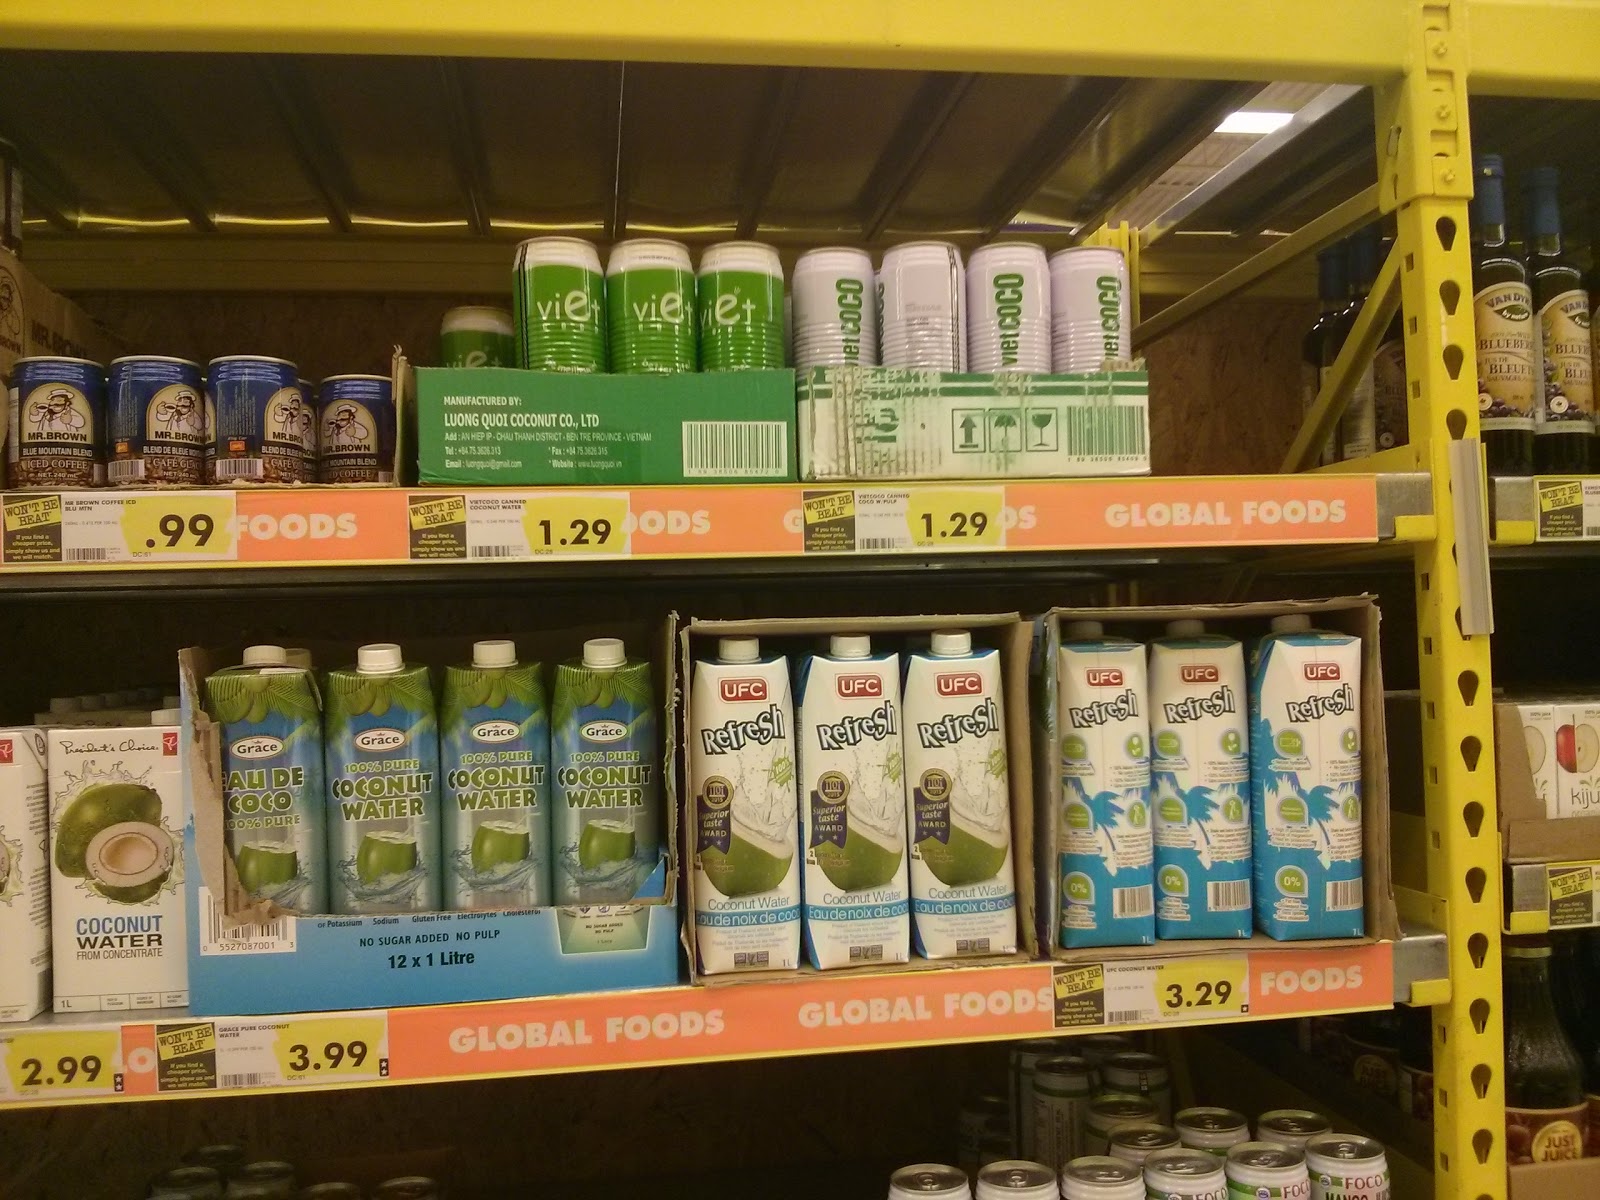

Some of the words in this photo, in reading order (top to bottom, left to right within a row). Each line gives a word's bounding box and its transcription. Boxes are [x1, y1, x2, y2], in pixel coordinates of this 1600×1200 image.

[444, 397, 507, 405] MANUFACTURED
[509, 397, 522, 406] BY:
[445, 414, 479, 427] LUONG
[482, 414, 508, 429] QUOI
[510, 414, 557, 427] COCONUT
[581, 414, 599, 427] LTD
[28, 432, 87, 442] MR.BROWN
[536, 433, 561, 441] DISTRICT
[592, 433, 622, 441] PROVINCE
[627, 433, 651, 441] VIETNAM
[38, 447, 72, 456] MOUNTAIN
[73, 448, 93, 457] BLEND
[172, 447, 188, 455] BLEUE
[27, 460, 49, 468] ICED
[52, 460, 87, 469] COFFEE
[5, 502, 40, 517] WON'T
[42, 499, 58, 510] BE
[411, 503, 444, 516] WON'T
[446, 500, 463, 510] BE
[805, 498, 835, 512] WON'T
[838, 494, 852, 505] BE
[18, 512, 50, 526] BEAT
[424, 512, 454, 525] BEAT
[816, 507, 844, 519] BEAT
[1104, 501, 1231, 528] GLOBAL
[1243, 499, 1346, 524] FOODS
[146, 514, 214, 547] .99
[236, 513, 358, 540] FOODS
[539, 519, 611, 545] 1.29
[921, 512, 987, 538] 1.29
[1089, 672, 1121, 684] UFC
[1184, 669, 1216, 680] UFC
[1307, 665, 1338, 678] UFC
[724, 682, 763, 698] UFC
[841, 679, 878, 693] UFC
[940, 677, 978, 692] UFC
[477, 726, 515, 737] Grace
[586, 726, 622, 736] Grace
[361, 735, 400, 745] Grace
[237, 742, 278, 754] Grace
[461, 753, 497, 764] 100%
[499, 751, 533, 762] PURE
[570, 752, 604, 763] 100%
[607, 751, 640, 762] PURE
[345, 761, 382, 773] 100%
[384, 759, 419, 772] PURE
[272, 766, 304, 788] DE
[448, 765, 545, 790] COCONUT
[557, 764, 651, 789] COCONUT
[332, 773, 433, 800] COCONUT
[228, 790, 293, 815] COCO
[457, 788, 537, 811] WATER
[566, 788, 643, 810] WATER
[341, 796, 425, 822] WATER
[812, 804, 846, 816] Superior
[921, 810, 942, 819] taste
[265, 815, 300, 827] PURE
[818, 813, 839, 822] taste
[1165, 876, 1181, 886] 0%
[1283, 876, 1300, 887] 0%
[823, 893, 870, 904] Coconut
[873, 891, 901, 902] Water
[928, 888, 975, 899] Coconut
[978, 885, 1007, 896] Water
[708, 899, 755, 910] Coconut
[758, 897, 790, 908] Water
[935, 903, 952, 913] de
[953, 901, 978, 913] noix
[980, 900, 995, 912] de
[714, 914, 731, 925] de
[732, 913, 757, 925] noix
[760, 912, 776, 923] de
[809, 906, 828, 919] Eau
[830, 908, 847, 920] de
[848, 907, 872, 919] noix
[874, 905, 890, 917] de
[76, 915, 162, 935] COCONUT
[327, 919, 362, 927] Potassium
[373, 917, 399, 925] Sodium
[412, 915, 435, 923] Gluten
[76, 934, 163, 949] WATER
[360, 938, 374, 947] NO
[379, 936, 411, 946] SUGAR
[415, 933, 449, 944] ADDED
[456, 932, 470, 941] NO
[475, 929, 500, 940] PULP
[77, 951, 100, 960] FROM
[103, 948, 162, 959] CONCENTRATE
[388, 955, 407, 968] 12
[427, 953, 433, 966] 1
[440, 951, 475, 966] Litre
[1055, 972, 1085, 986] WON'T
[1088, 968, 1101, 979] BE
[1261, 966, 1363, 996] FOODS
[1068, 980, 1094, 994] BEAT
[1165, 979, 1232, 1009] 3.29
[799, 996, 932, 1028] GLOBAL
[944, 987, 1052, 1018] FOODS
[159, 1031, 193, 1046] WON'T
[196, 1027, 212, 1039] BE
[449, 1019, 592, 1054] GLOBAL
[606, 1009, 725, 1042] FOODS
[172, 1040, 204, 1055] BEAT
[289, 1041, 368, 1072] 3.99
[21, 1055, 102, 1086] 2.99
[1344, 1174, 1383, 1190] FOCO
